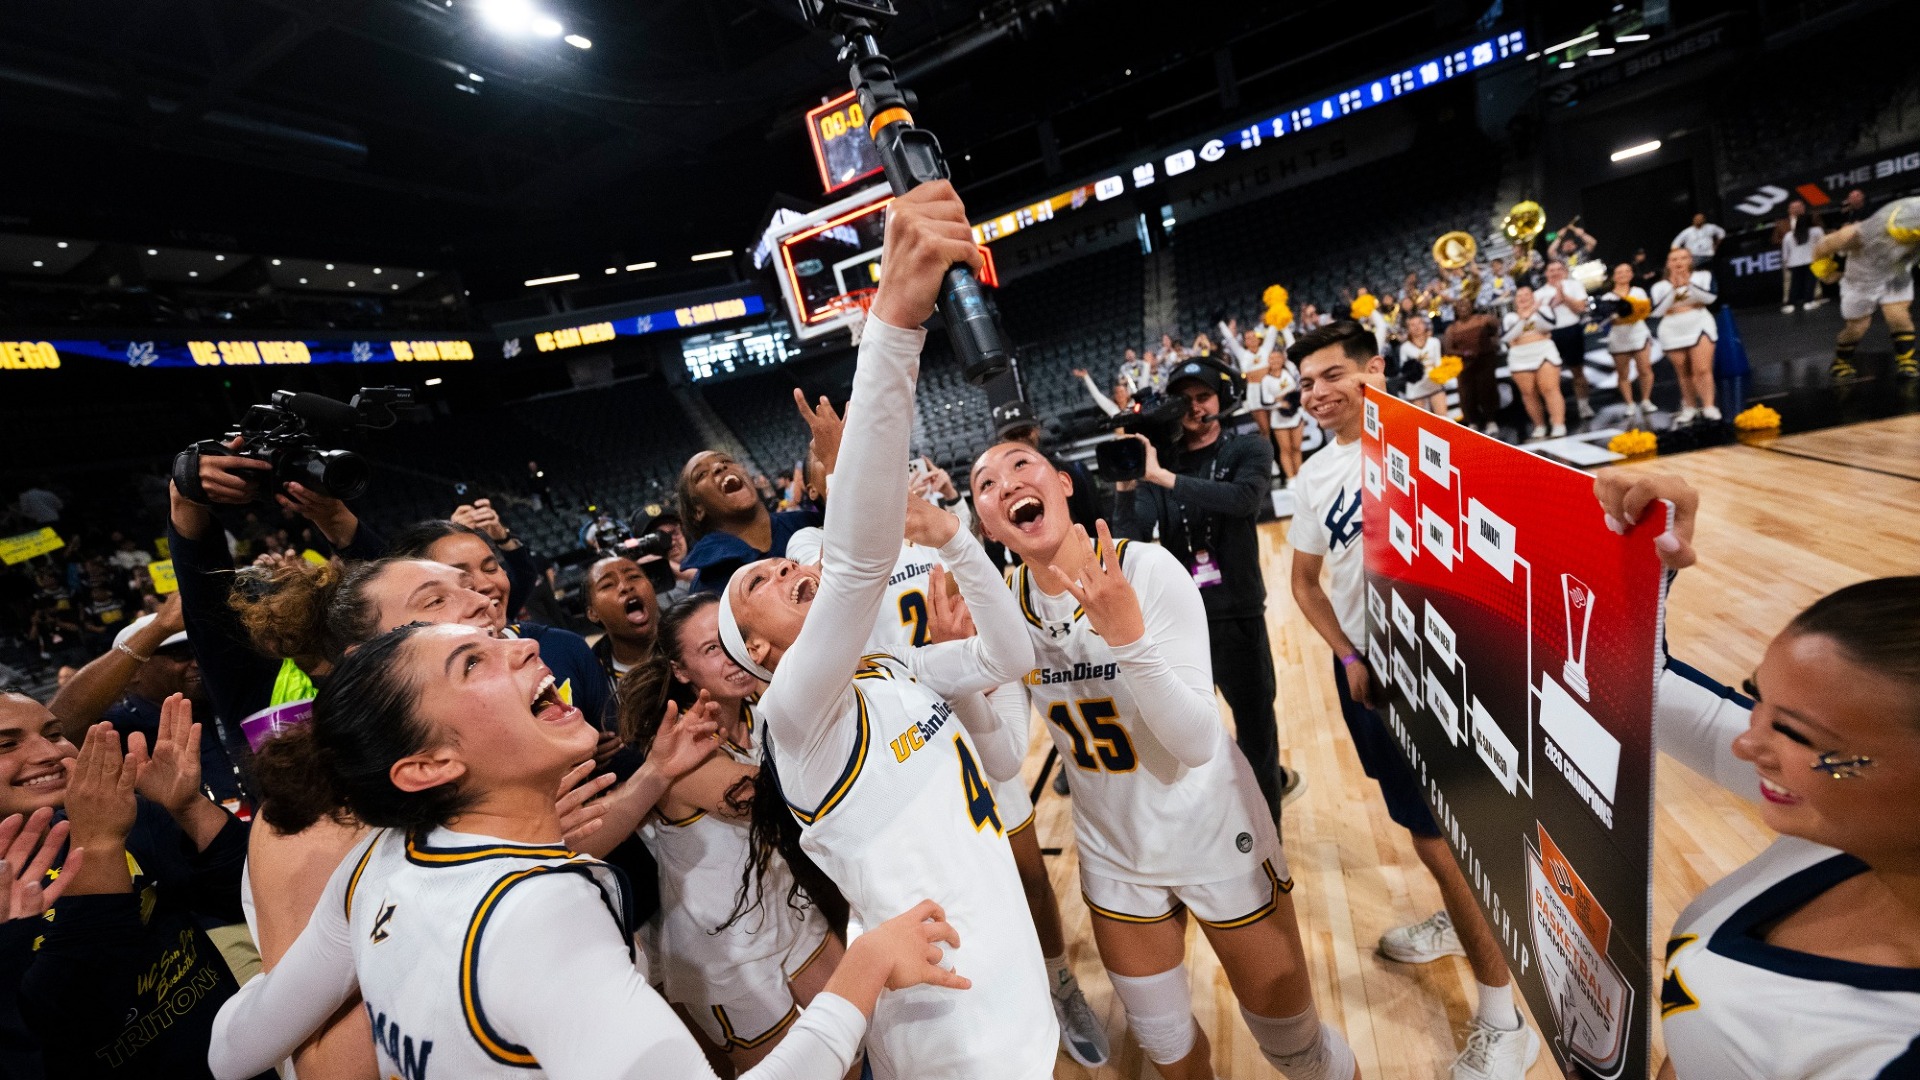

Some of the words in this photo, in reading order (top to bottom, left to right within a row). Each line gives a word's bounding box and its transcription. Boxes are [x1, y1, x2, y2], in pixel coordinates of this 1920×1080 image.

[1190, 139, 1347, 207] KNIGHTS
[1875, 152, 1920, 179] BIG
[1730, 250, 1782, 277] THE
[0, 341, 61, 370] IEGO
[896, 587, 933, 649] 2
[1022, 661, 1122, 686] UCSanDieg
[889, 701, 953, 763] UCSanDie
[1047, 695, 1139, 775] 15
[952, 731, 1005, 839] 4
[1544, 736, 1563, 773] 2026
[1563, 758, 1613, 830] CHAMPIONS
[1389, 701, 1427, 787] WOMEN'S
[1430, 778, 1530, 976] CHAMPIONSHIP
[1544, 885, 1568, 926] Credit
[1535, 888, 1615, 1021] BASKETBALL
[1537, 910, 1611, 1033] CHAMPIONSHIPS
